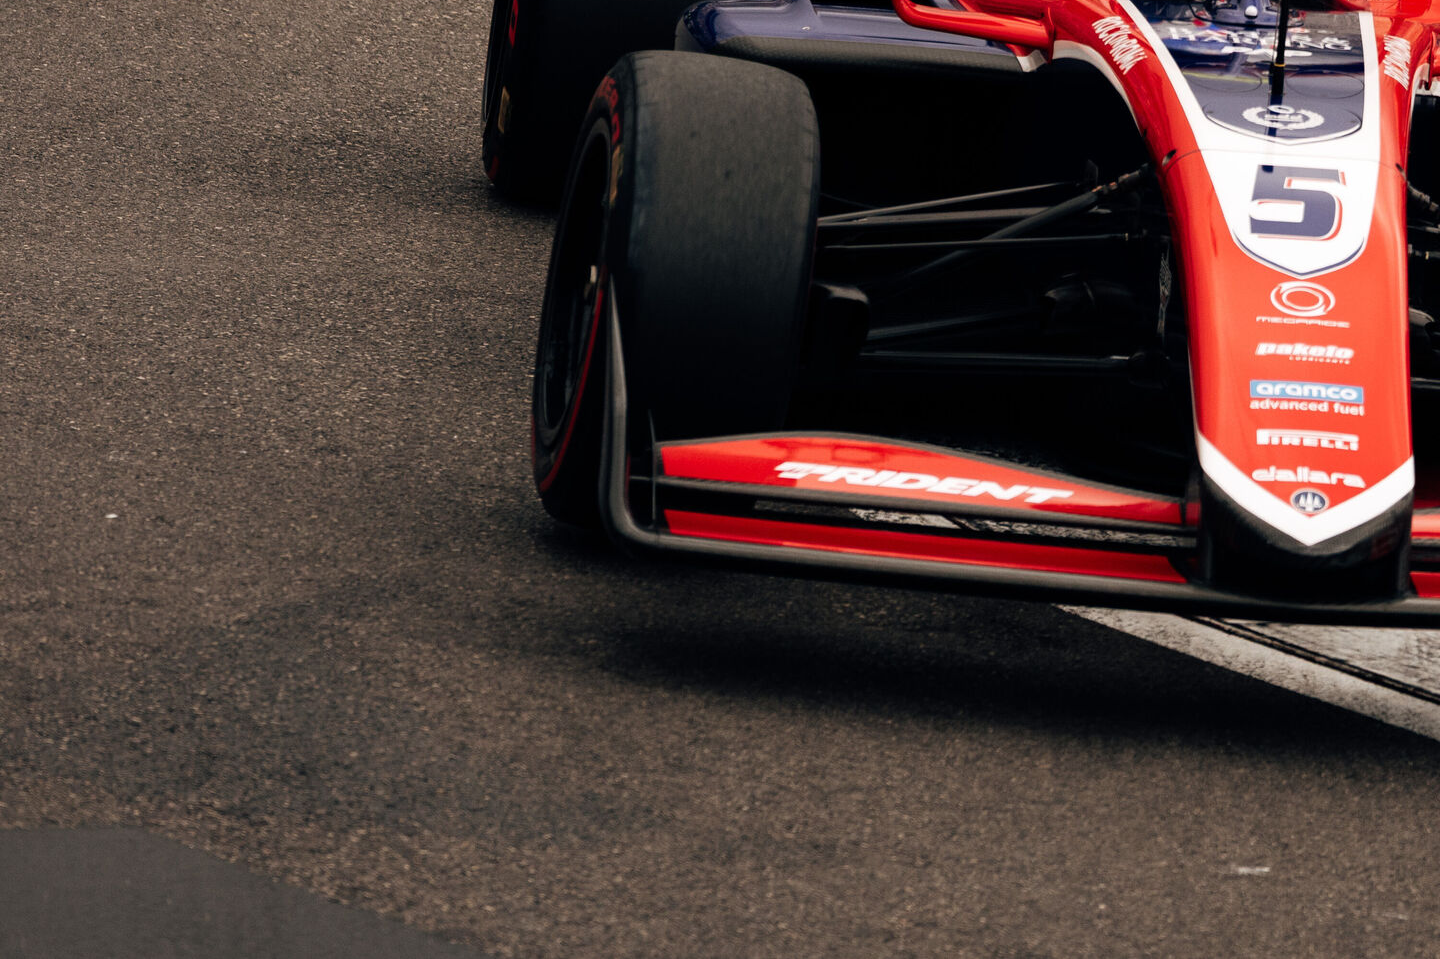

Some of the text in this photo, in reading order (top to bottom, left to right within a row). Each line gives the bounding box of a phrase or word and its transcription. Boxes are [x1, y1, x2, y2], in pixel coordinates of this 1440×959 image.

[1249, 164, 1347, 241] 5
[1255, 342, 1354, 359] pakelo
[1256, 382, 1358, 401] aramco
[1250, 398, 1365, 416] advanced fuel
[1256, 428, 1359, 451] PIRELLI
[774, 461, 1075, 504] TRIDENT
[1251, 466, 1366, 488] dallara
